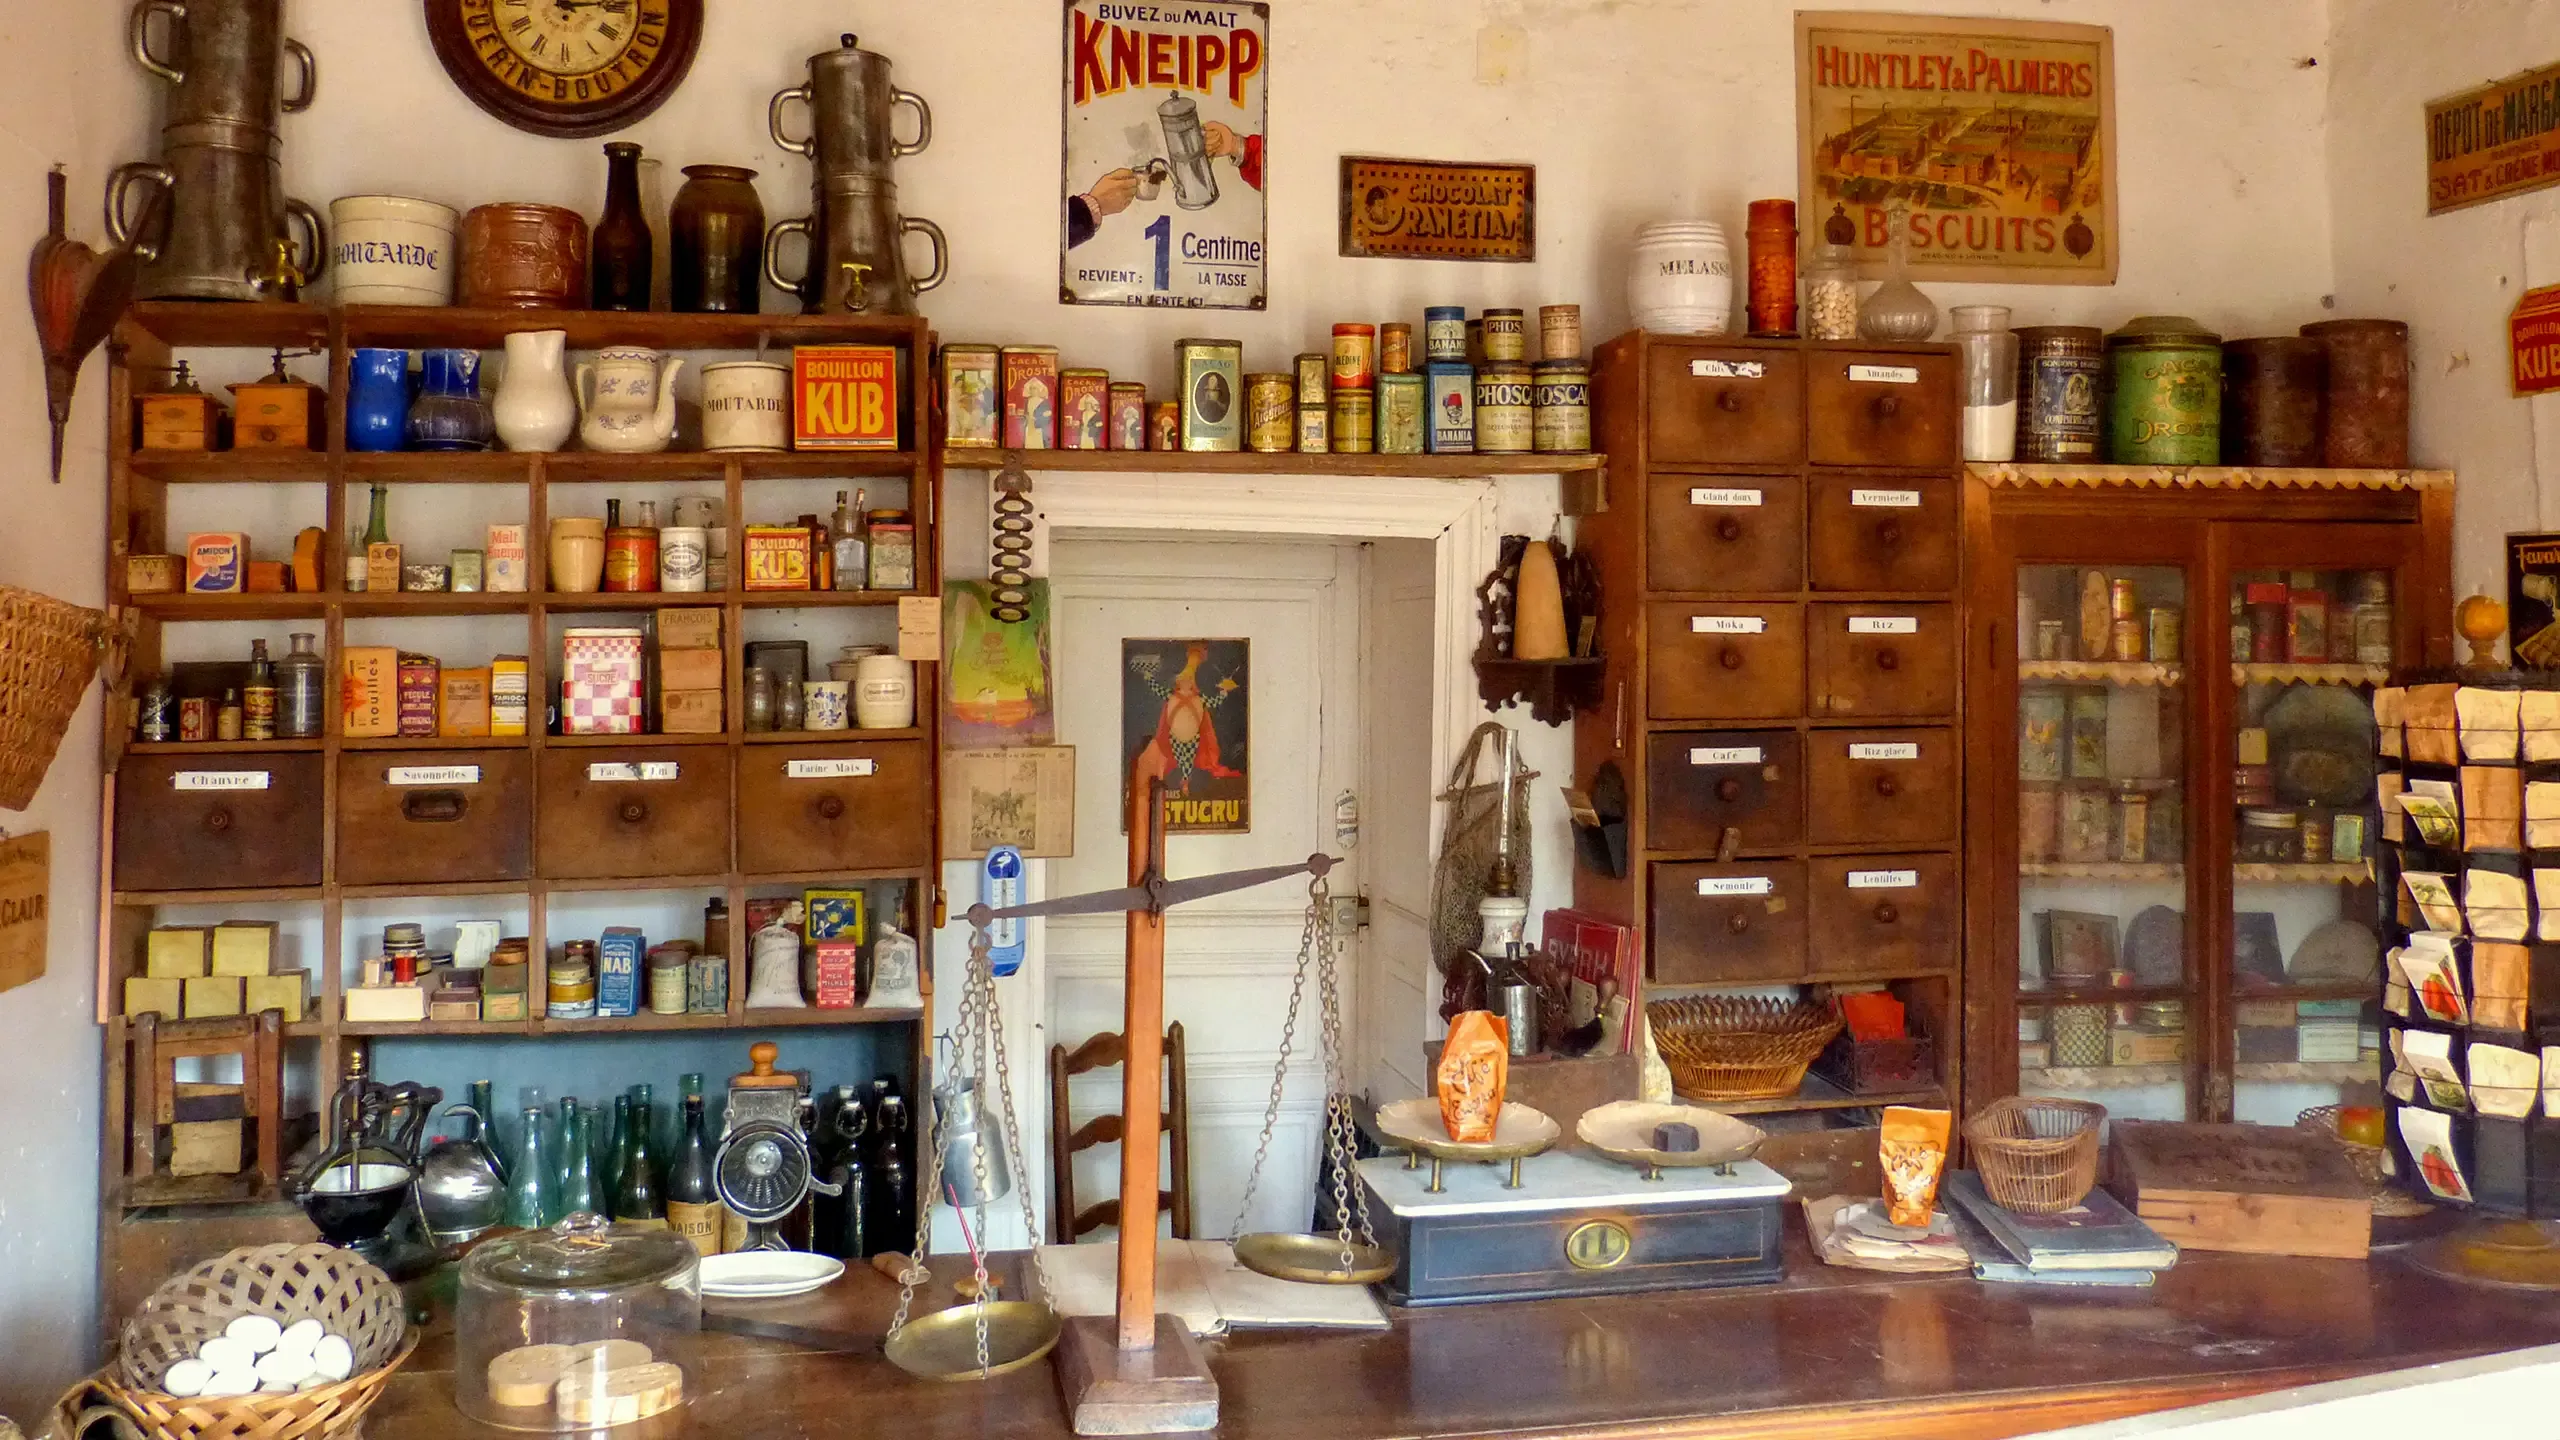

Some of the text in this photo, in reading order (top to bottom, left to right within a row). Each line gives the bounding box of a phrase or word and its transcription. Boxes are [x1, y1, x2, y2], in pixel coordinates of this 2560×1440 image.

[1100, 4, 1238, 28] BUVEZ DU MALT
[1074, 9, 1263, 109] KNEIPP
[1816, 45, 1953, 91] HUNTLEY
[1967, 48, 2093, 98] PALMERS
[1407, 184, 1513, 207] CHOCOLAT
[1863, 207, 2056, 253] BSCUITS
[1145, 215, 1171, 291] 1
[1181, 232, 1261, 261] Centime
[1659, 259, 1729, 277] MELASS
[1198, 271, 1247, 287] LA TASSE
[1127, 295, 1203, 307] EN VENTE ICI
[1488, 321, 1521, 333] PHOS
[1428, 339, 1466, 351] BANANI
[806, 361, 884, 379] BOUILLON
[1008, 357, 1046, 366] CACAO
[2518, 343, 2560, 381] KUB
[1007, 366, 1055, 391] DROSTE
[1866, 369, 1903, 380] Amandes
[1065, 385, 1105, 404] DROSTE
[1476, 385, 1531, 406] PHOSC
[707, 397, 785, 412] MOUTARDE
[806, 381, 885, 434] KUB
[1437, 431, 1472, 443] BANANIA
[491, 530, 518, 544] Malt
[750, 537, 804, 550] BOUILLON
[750, 550, 805, 580] KUB
[1716, 620, 1744, 630] Moka
[1872, 620, 1894, 630] Riz
[587, 673, 617, 684] SUCRE
[366, 658, 380, 726] nouilles
[493, 695, 525, 703] TAPIOCA
[1865, 747, 1881, 756] Riz
[1713, 881, 1755, 891] Semoule
[603, 957, 632, 975] NAB
